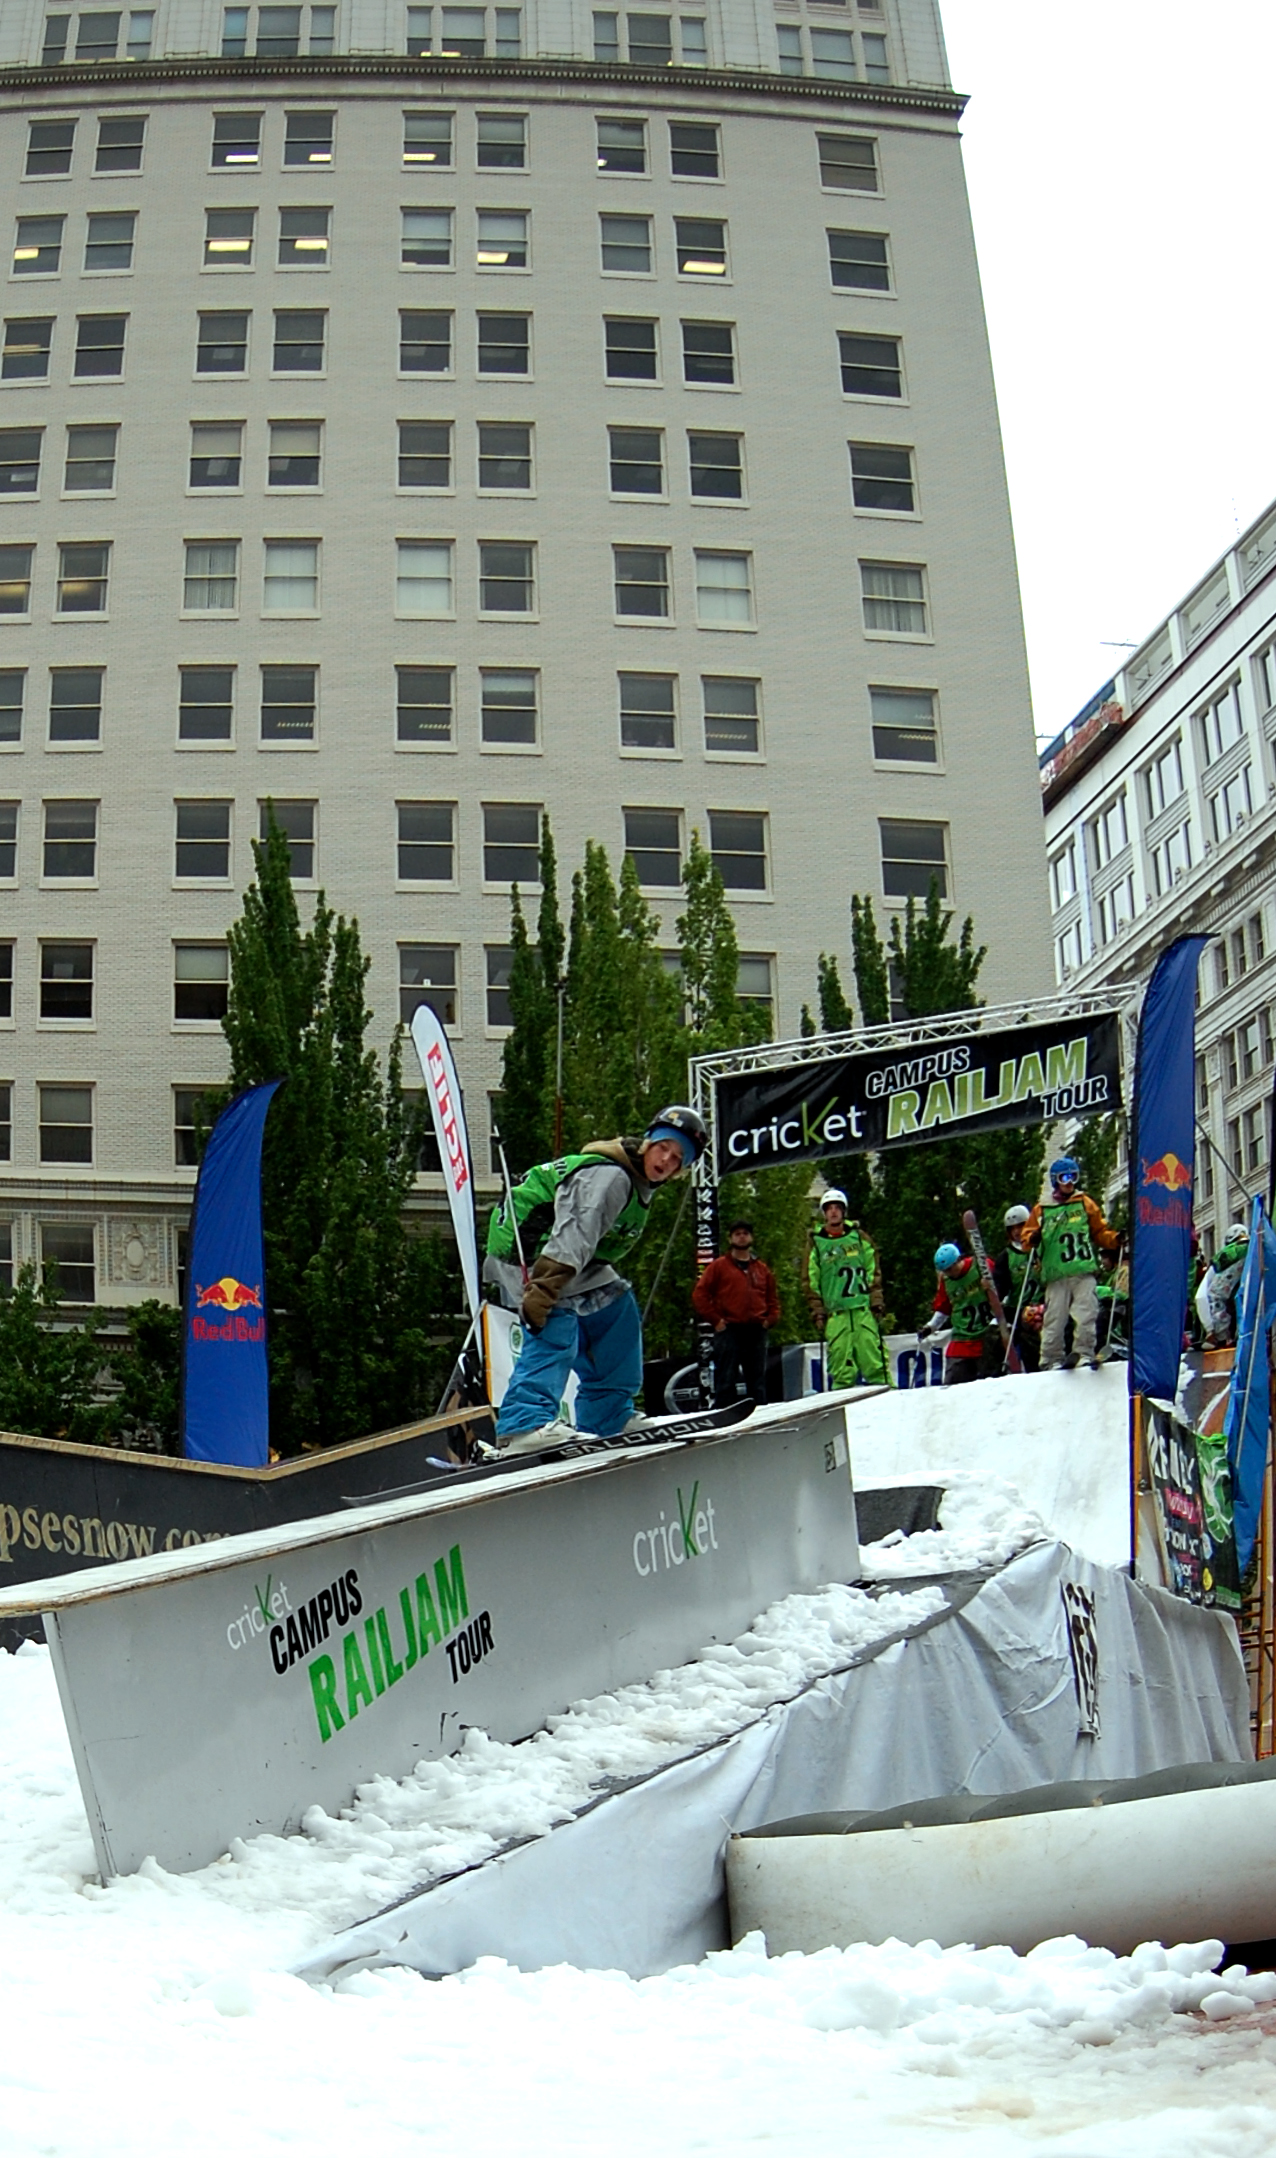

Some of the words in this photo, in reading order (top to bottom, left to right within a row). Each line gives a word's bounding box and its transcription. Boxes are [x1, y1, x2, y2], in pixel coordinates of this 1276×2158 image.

[865, 1046, 970, 1099] CAMPUS
[886, 1037, 1088, 1140] RAILJAM
[1040, 1074, 1108, 1118] TOUR
[1059, 1232, 1092, 1263] 35
[838, 1266, 871, 1298] 23
[193, 1315, 234, 1341] Red
[235, 1315, 265, 1342] Bul
[559, 1419, 714, 1459] SALOMON
[269, 1568, 363, 1675] CAMPUS
[308, 1543, 469, 1744] RAILJAM
[445, 1610, 495, 1684] TOUR
